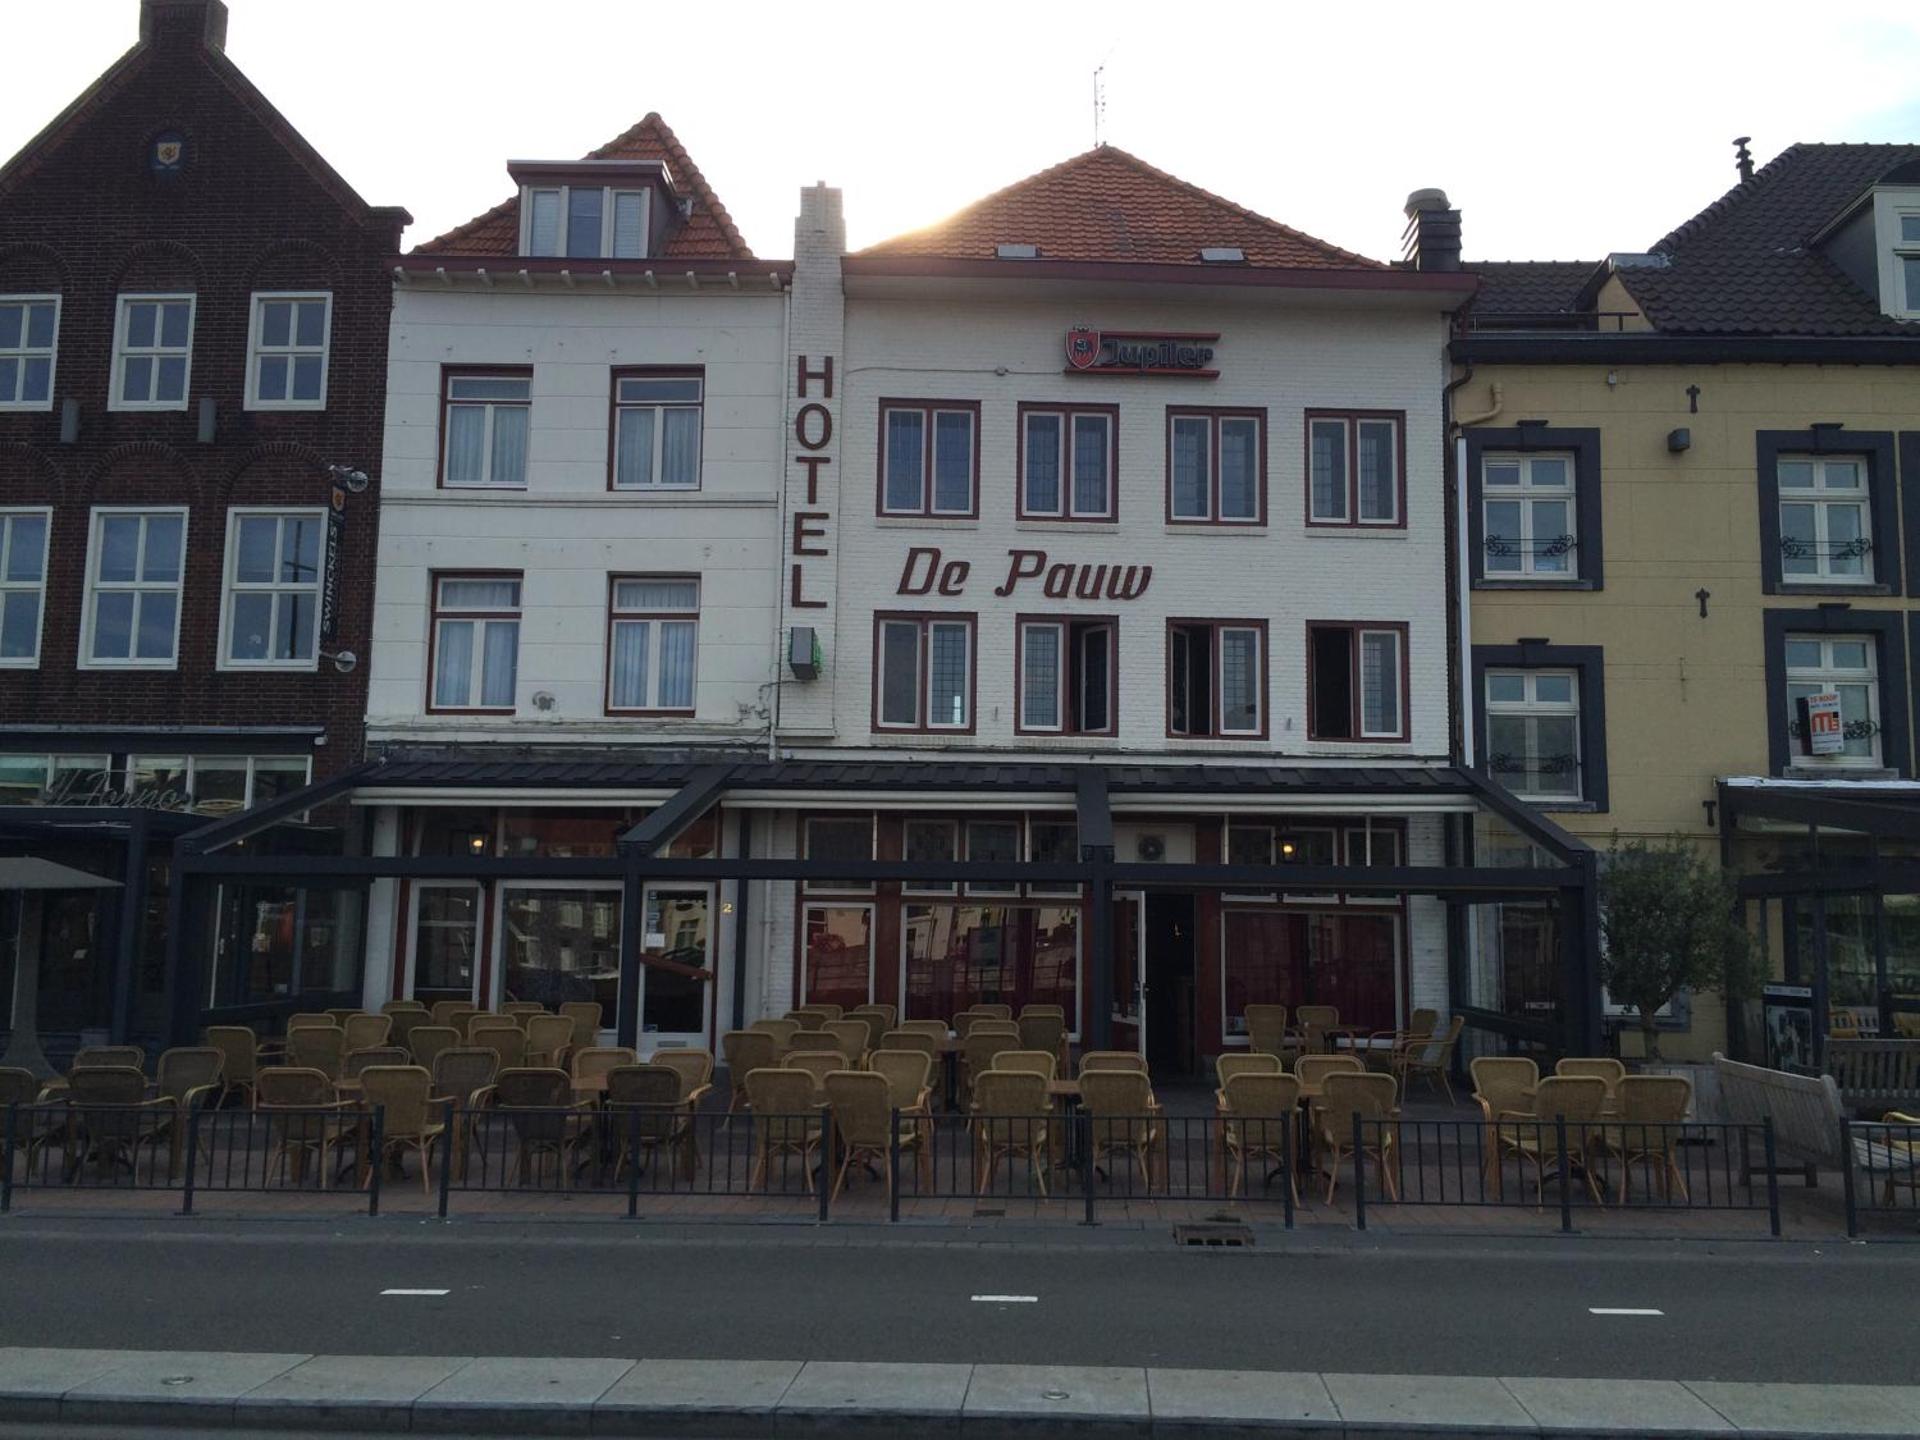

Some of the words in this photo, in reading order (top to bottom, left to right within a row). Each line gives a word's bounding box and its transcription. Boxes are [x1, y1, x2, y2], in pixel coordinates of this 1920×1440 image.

[1099, 339, 1213, 368] Jupiler
[792, 355, 833, 608] HOTEL
[897, 547, 970, 596] De
[995, 550, 1152, 600] Pauw
